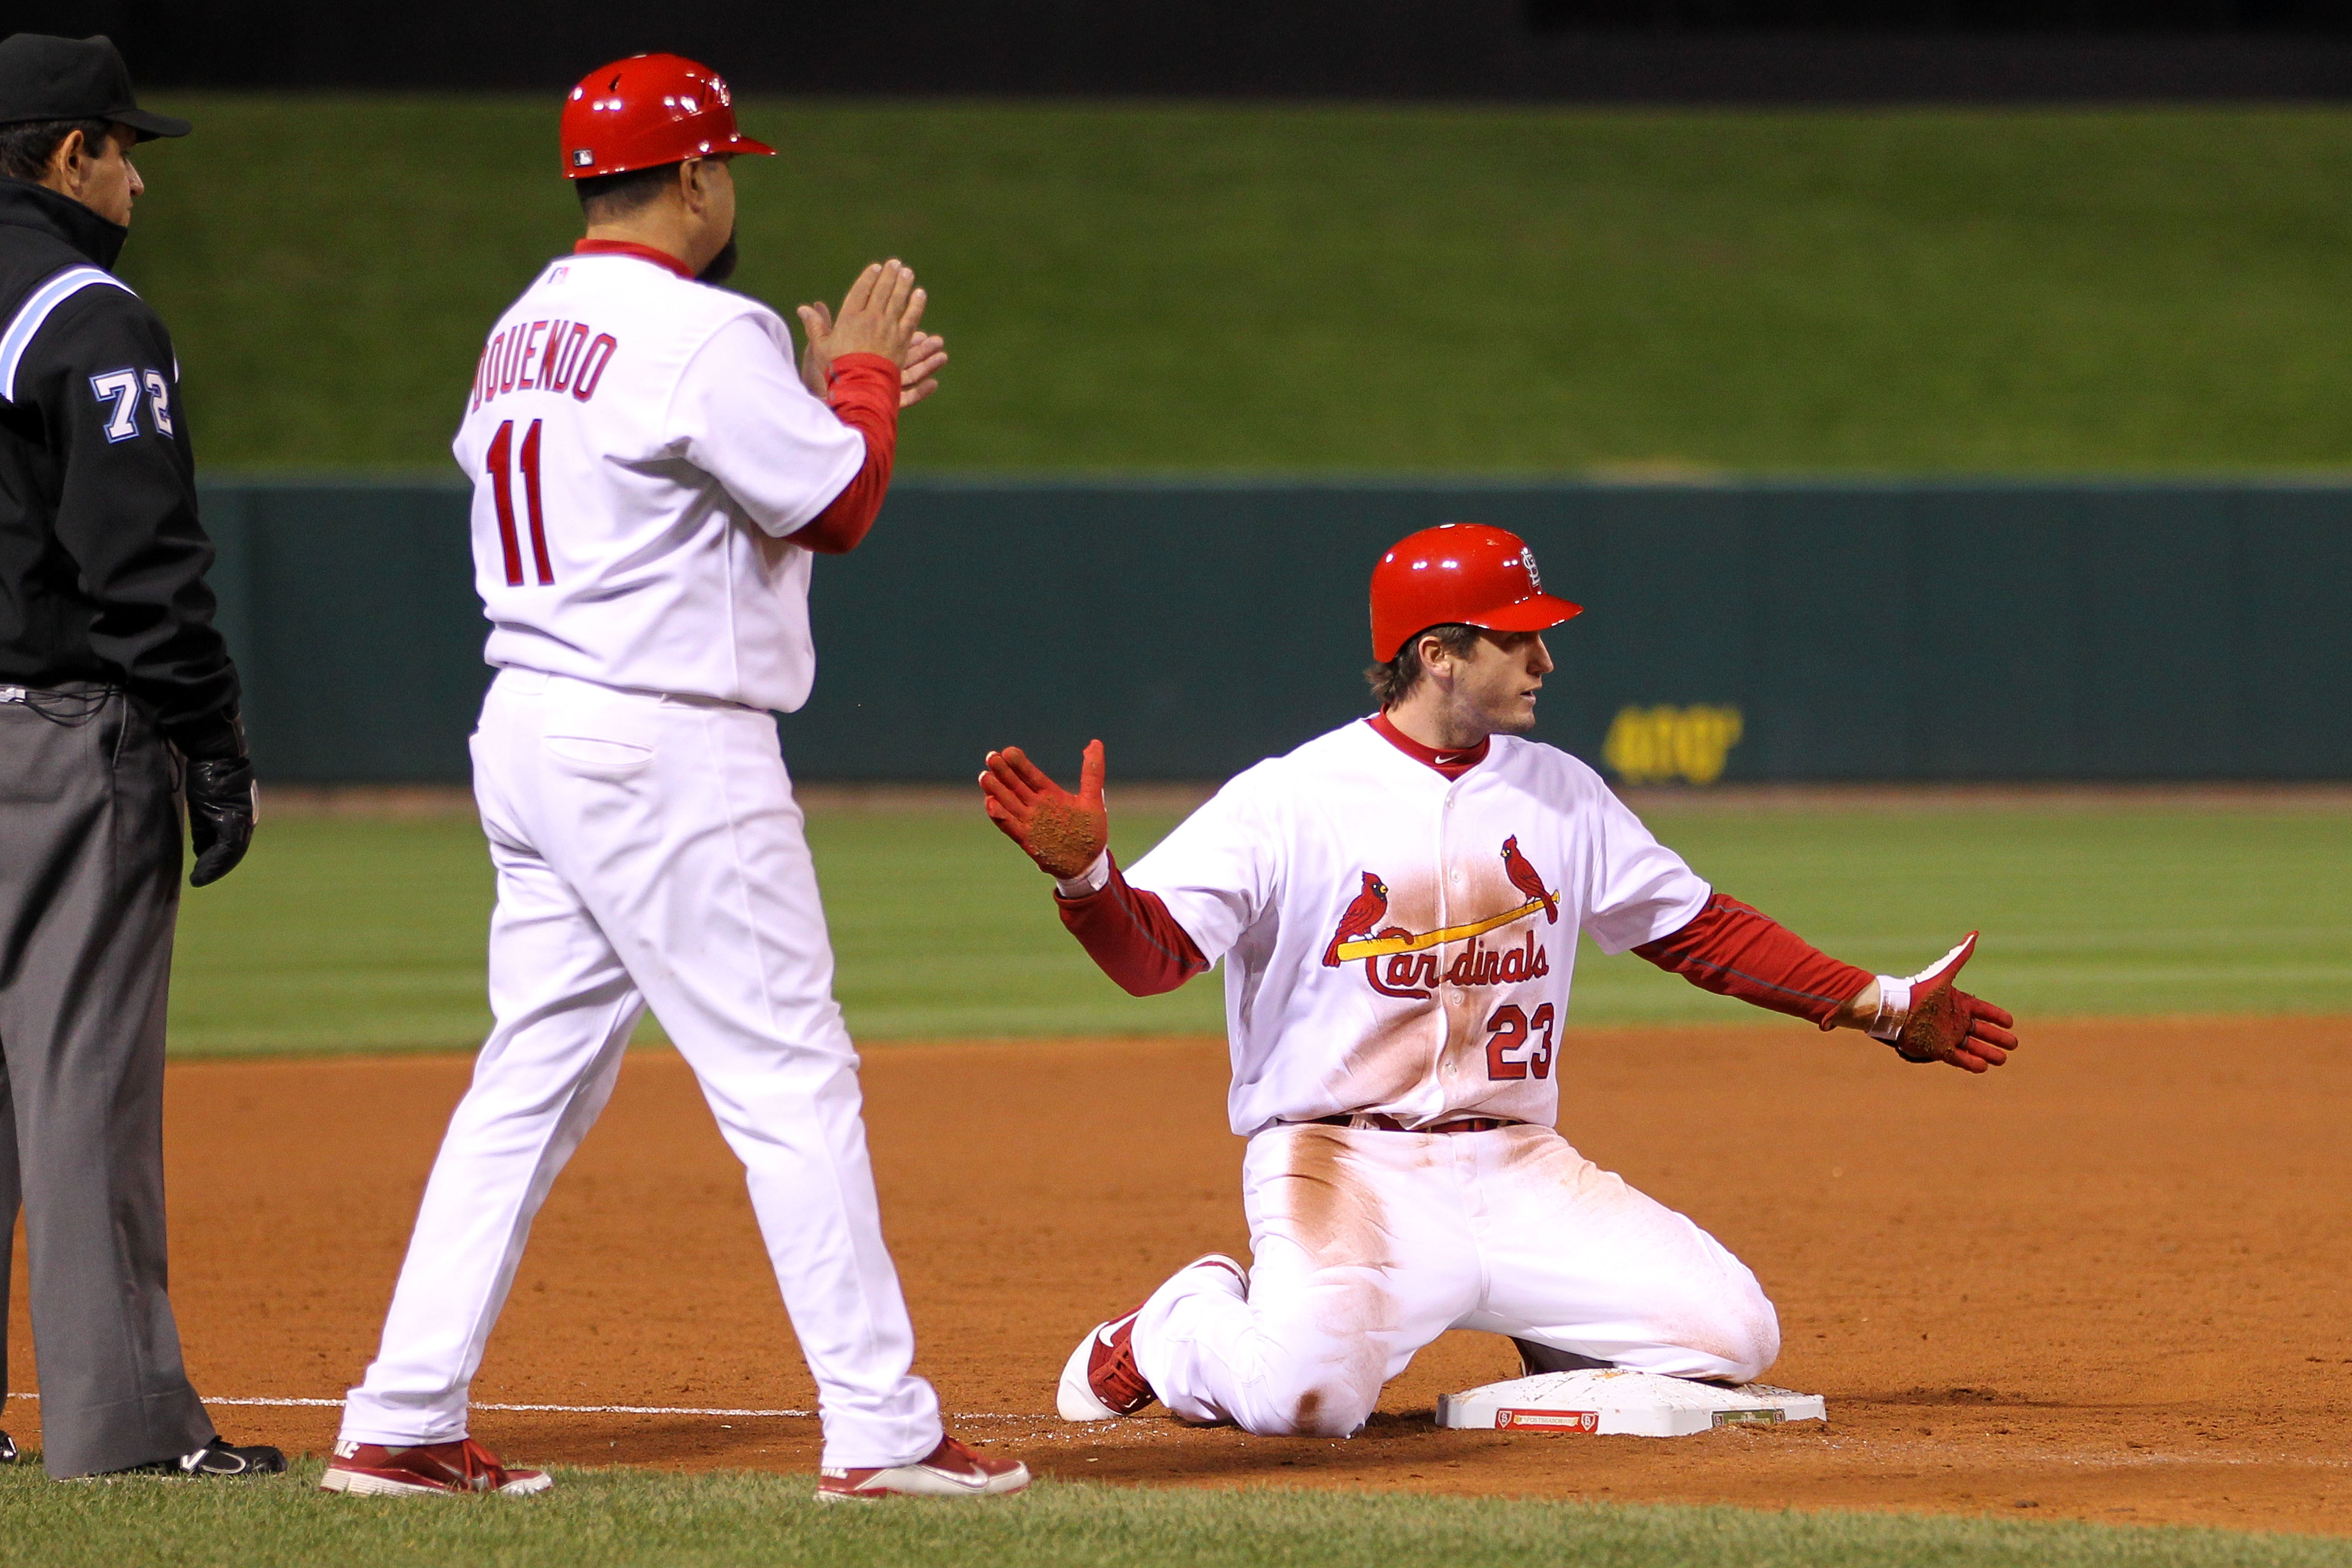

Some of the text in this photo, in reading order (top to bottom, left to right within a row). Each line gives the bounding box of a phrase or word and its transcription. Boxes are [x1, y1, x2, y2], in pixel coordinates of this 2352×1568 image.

[88, 367, 173, 444] 72
[487, 418, 555, 587] 11
[1365, 926, 1549, 1000] Cardinals
[1486, 1002, 1555, 1081] 23
